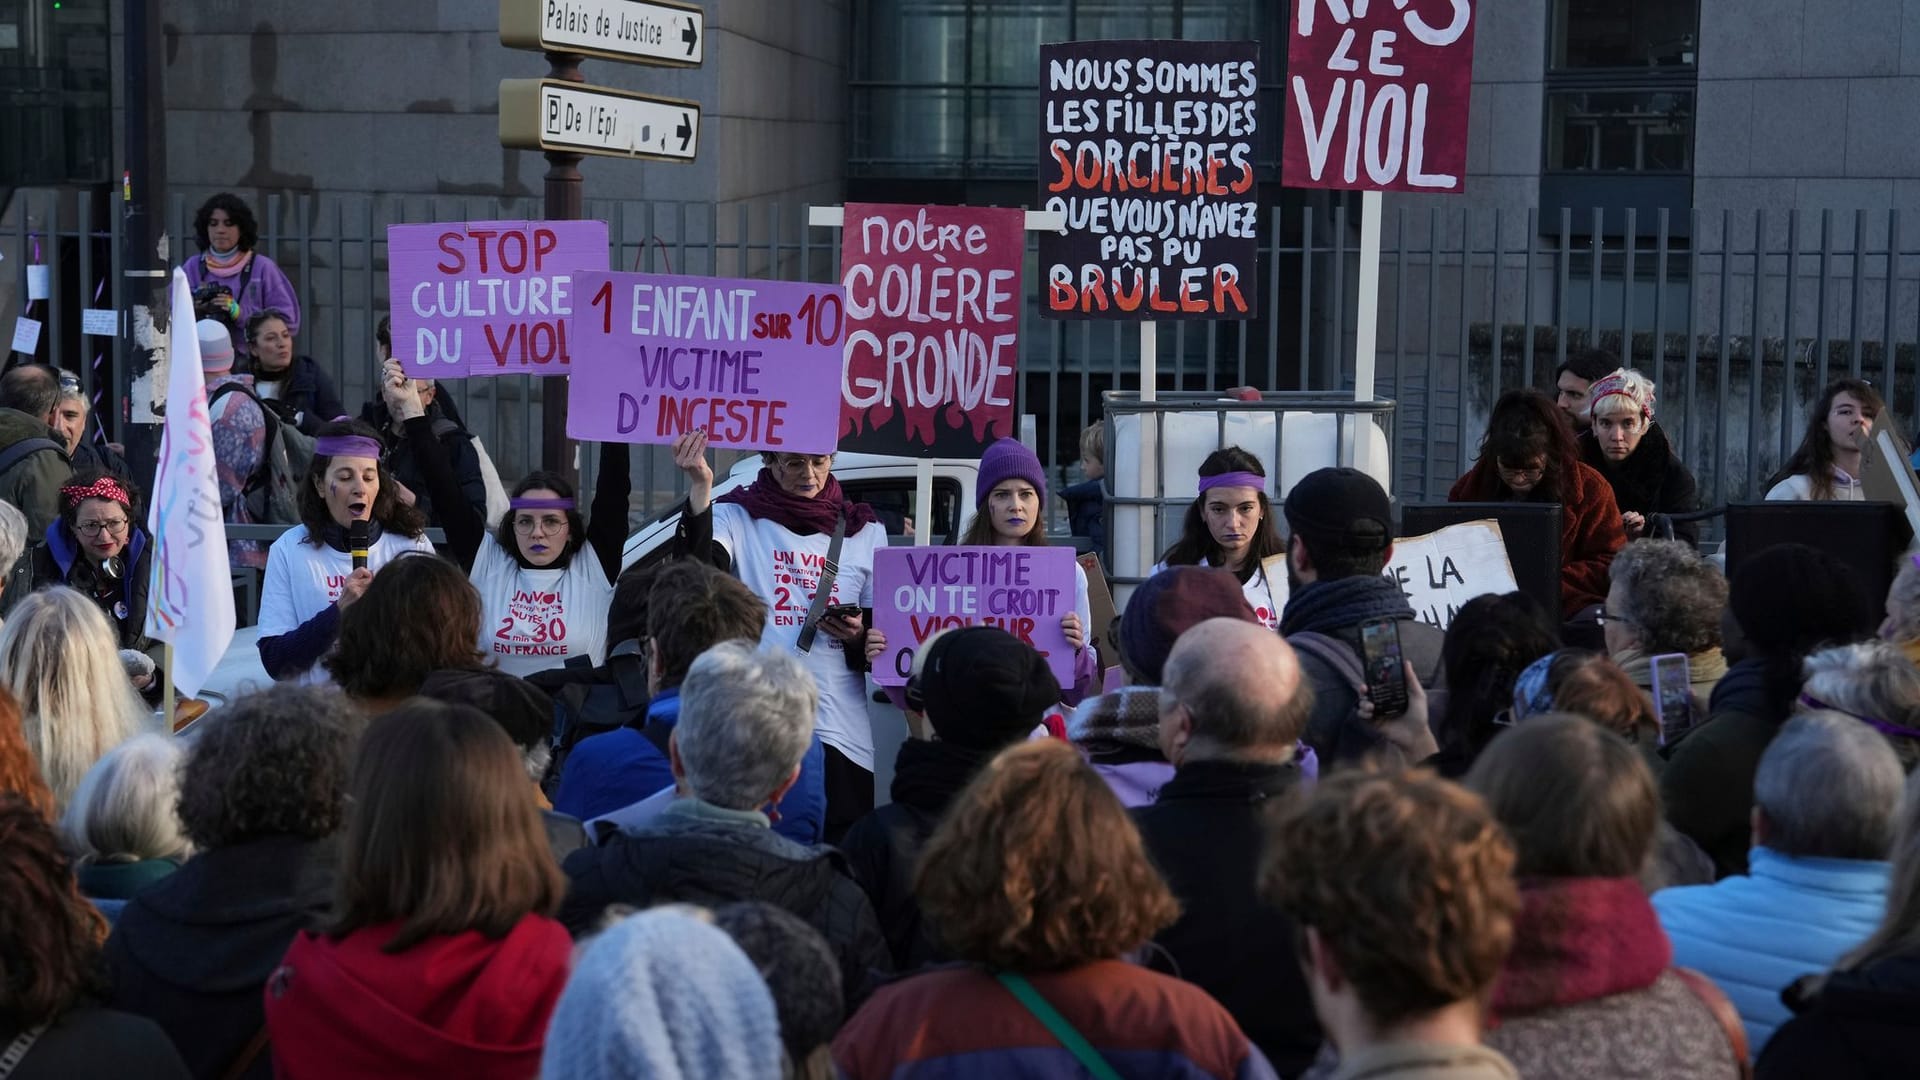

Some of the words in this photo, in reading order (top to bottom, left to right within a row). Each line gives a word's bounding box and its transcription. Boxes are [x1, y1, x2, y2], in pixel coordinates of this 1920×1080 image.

[547, 1, 588, 36] Palais
[595, 8, 610, 37] de
[617, 12, 662, 45] Justice
[1327, 28, 1404, 77] LE
[1050, 58, 1132, 92] NOUS
[1135, 58, 1257, 98] SOMMES
[565, 102, 581, 132] De
[1046, 99, 1100, 134] LES
[1210, 99, 1257, 137] DES
[1292, 75, 1457, 188] VIOL
[1045, 196, 1108, 237] QUE
[1110, 197, 1177, 240] VOUS
[1179, 194, 1258, 240] N'AVEZ
[436, 228, 558, 275] STOP
[1101, 235, 1153, 263] PAS
[1162, 237, 1202, 266] PU
[411, 275, 572, 318] CULTURE
[843, 252, 1016, 323] COLÈRE
[1049, 261, 1249, 313] BRÛLER
[591, 280, 613, 334] 1
[630, 283, 757, 342] ENFANT
[752, 312, 792, 340] SUR
[797, 293, 843, 347] 10
[415, 327, 463, 366] DU
[483, 319, 571, 367] VIOL
[639, 345, 763, 395] VICTIME
[841, 328, 1017, 412] GRONDE
[773, 549, 795, 565] UN
[800, 552, 827, 569] VIO
[905, 551, 1031, 586] VICTIME
[1425, 554, 1465, 589] LA
[773, 573, 817, 590] TOUTES
[774, 586, 792, 612] 2
[894, 585, 937, 615] ON
[943, 585, 977, 615] TE
[988, 588, 1061, 616] CROIT
[495, 617, 515, 641] 2
[531, 617, 567, 643] 30
[774, 615, 794, 627] EN
[493, 642, 511, 655] EN
[515, 645, 568, 656] FRANCE
